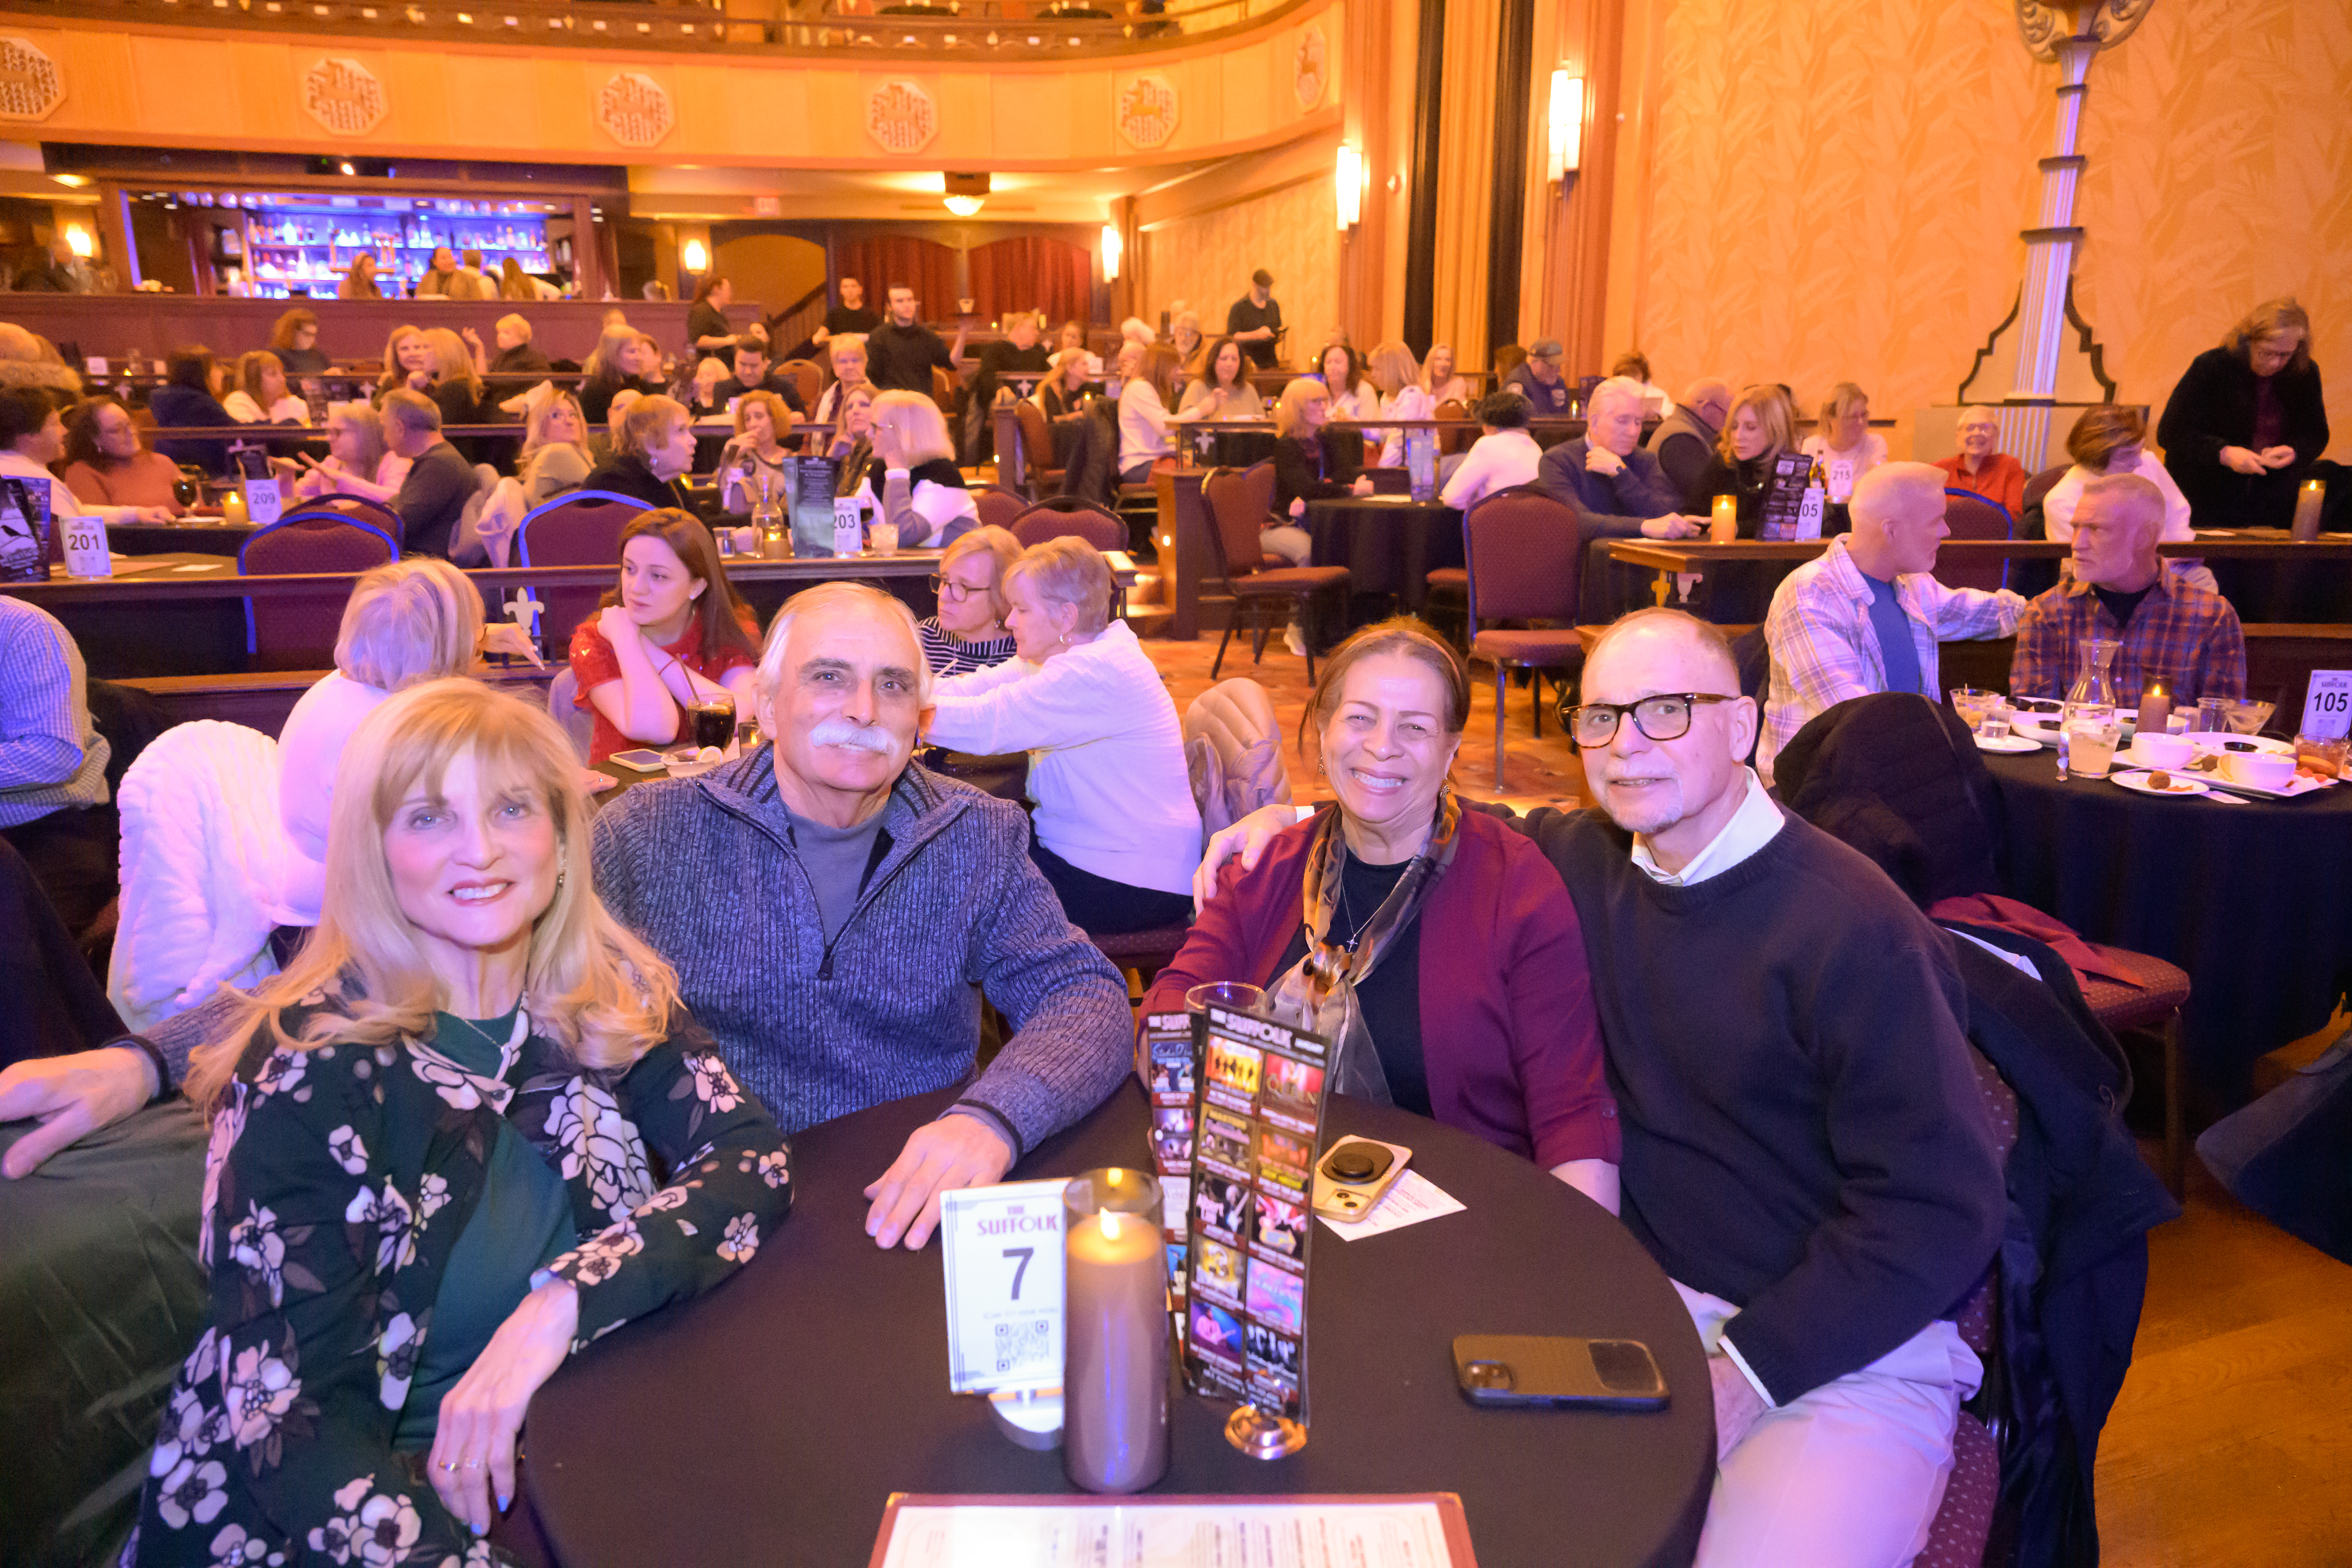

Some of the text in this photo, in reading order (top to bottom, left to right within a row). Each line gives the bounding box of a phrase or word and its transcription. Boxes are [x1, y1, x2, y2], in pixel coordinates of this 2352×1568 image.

[1833, 471, 1850, 480] 215
[253, 493, 275, 504] 209
[1802, 504, 1818, 517] 05
[68, 534, 99, 550] 201
[2314, 692, 2348, 712] 105
[1226, 1013, 1293, 1050] SUFFOLK
[977, 1214, 1059, 1236] SUFFOLK
[1003, 1247, 1033, 1300] 7
